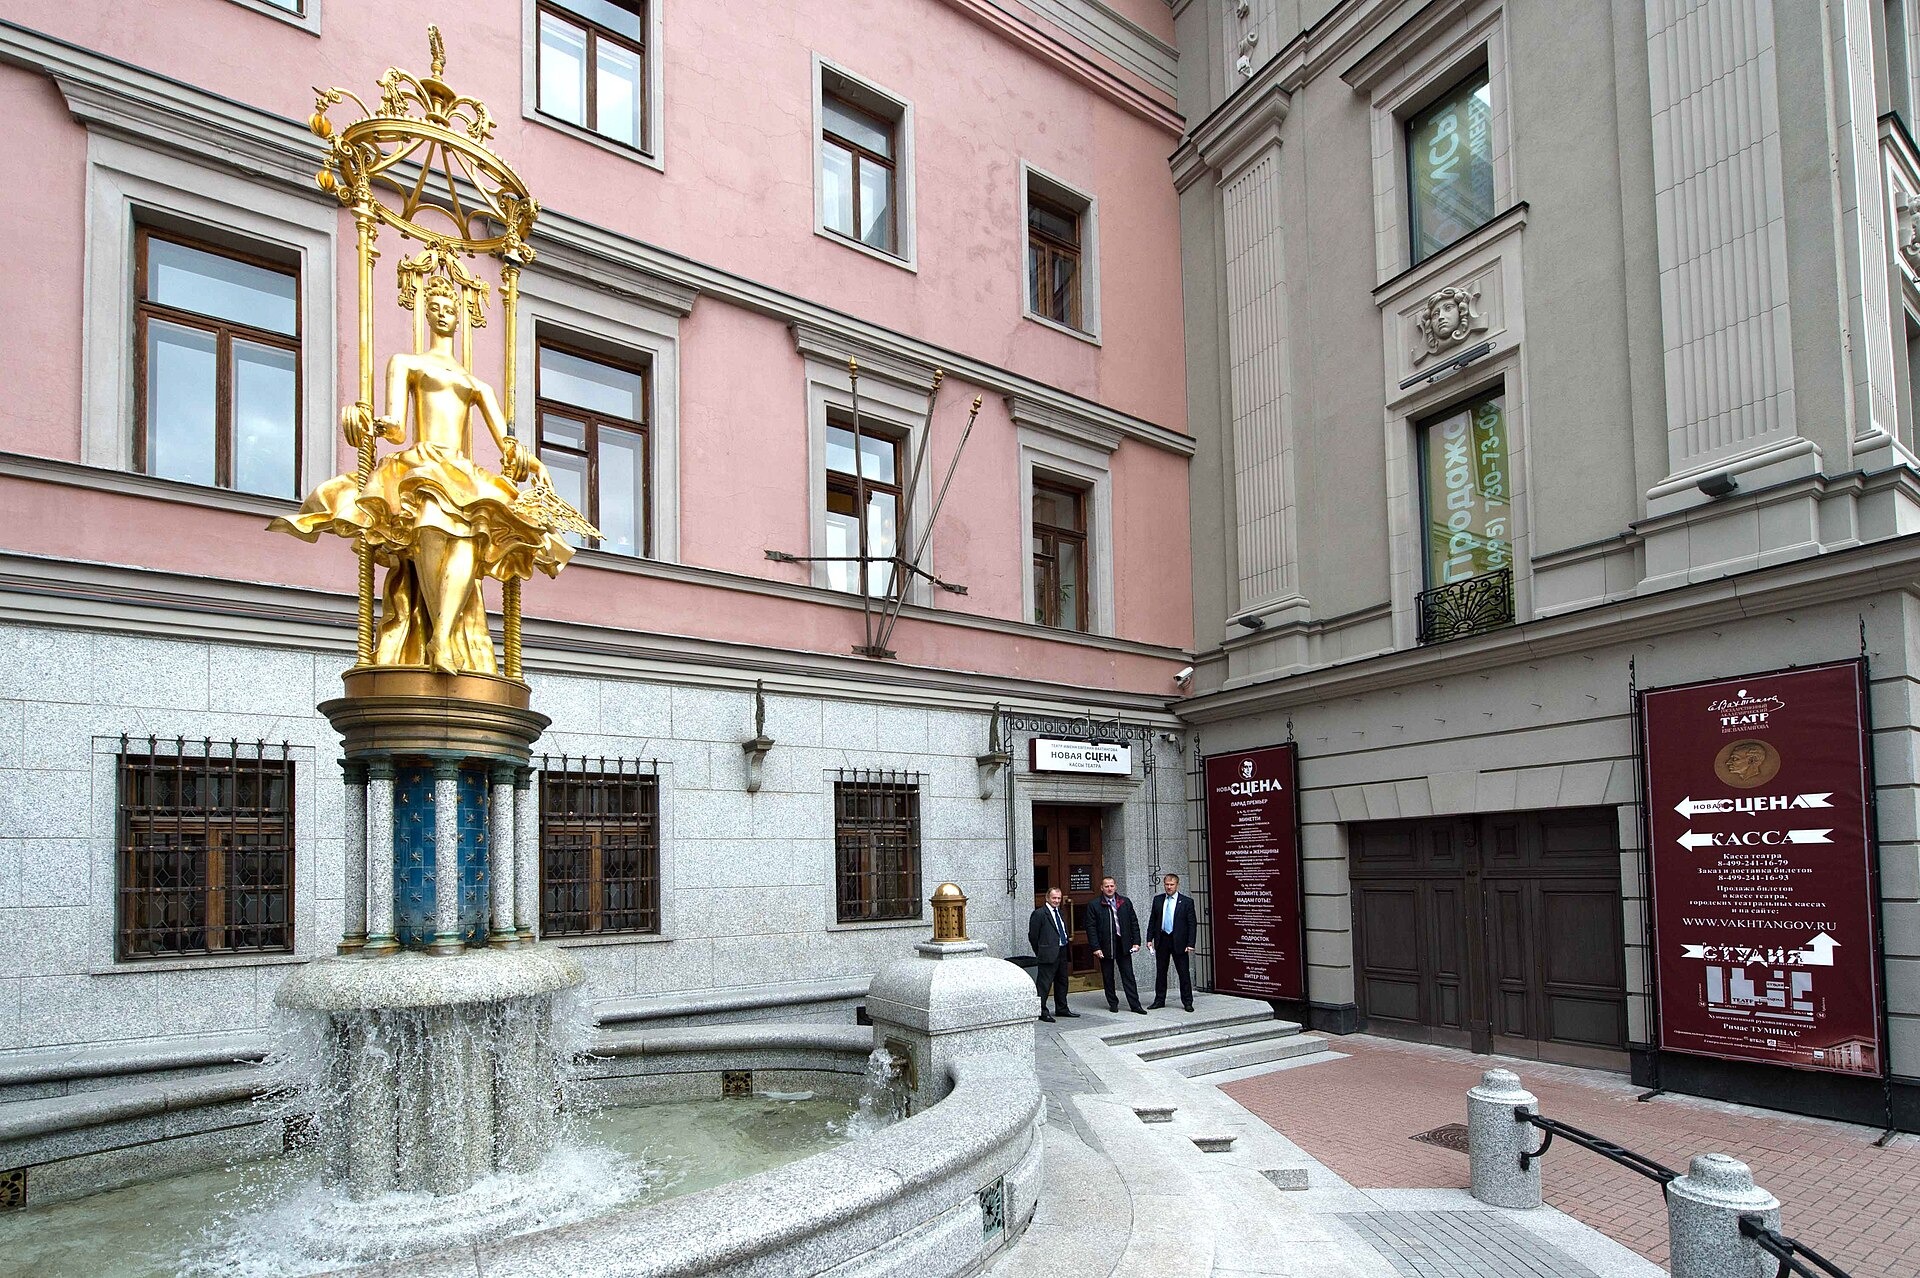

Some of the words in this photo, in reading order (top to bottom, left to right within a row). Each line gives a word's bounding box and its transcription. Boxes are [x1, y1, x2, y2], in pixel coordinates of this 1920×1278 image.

[1428, 102, 1461, 244] ОИСЫ
[1486, 517, 1508, 571] (495)
[1720, 712, 1769, 726] ТЕАТР
[1051, 751, 1082, 760] НОВАЯ
[1085, 752, 1118, 763] СЦЕНА
[1231, 779, 1282, 797] СЦЕНА
[1719, 795, 1810, 816] СЦЕНА
[1712, 830, 1794, 846] КАССА
[1682, 918, 1836, 930] WWW.VAKHTANGOV.RU
[1703, 946, 1804, 966] СТУДИЯ
[1708, 1014, 1754, 1023] Художественный
[1723, 1023, 1748, 1031] Римас
[1750, 1026, 1800, 1037] ТУМИНАС
